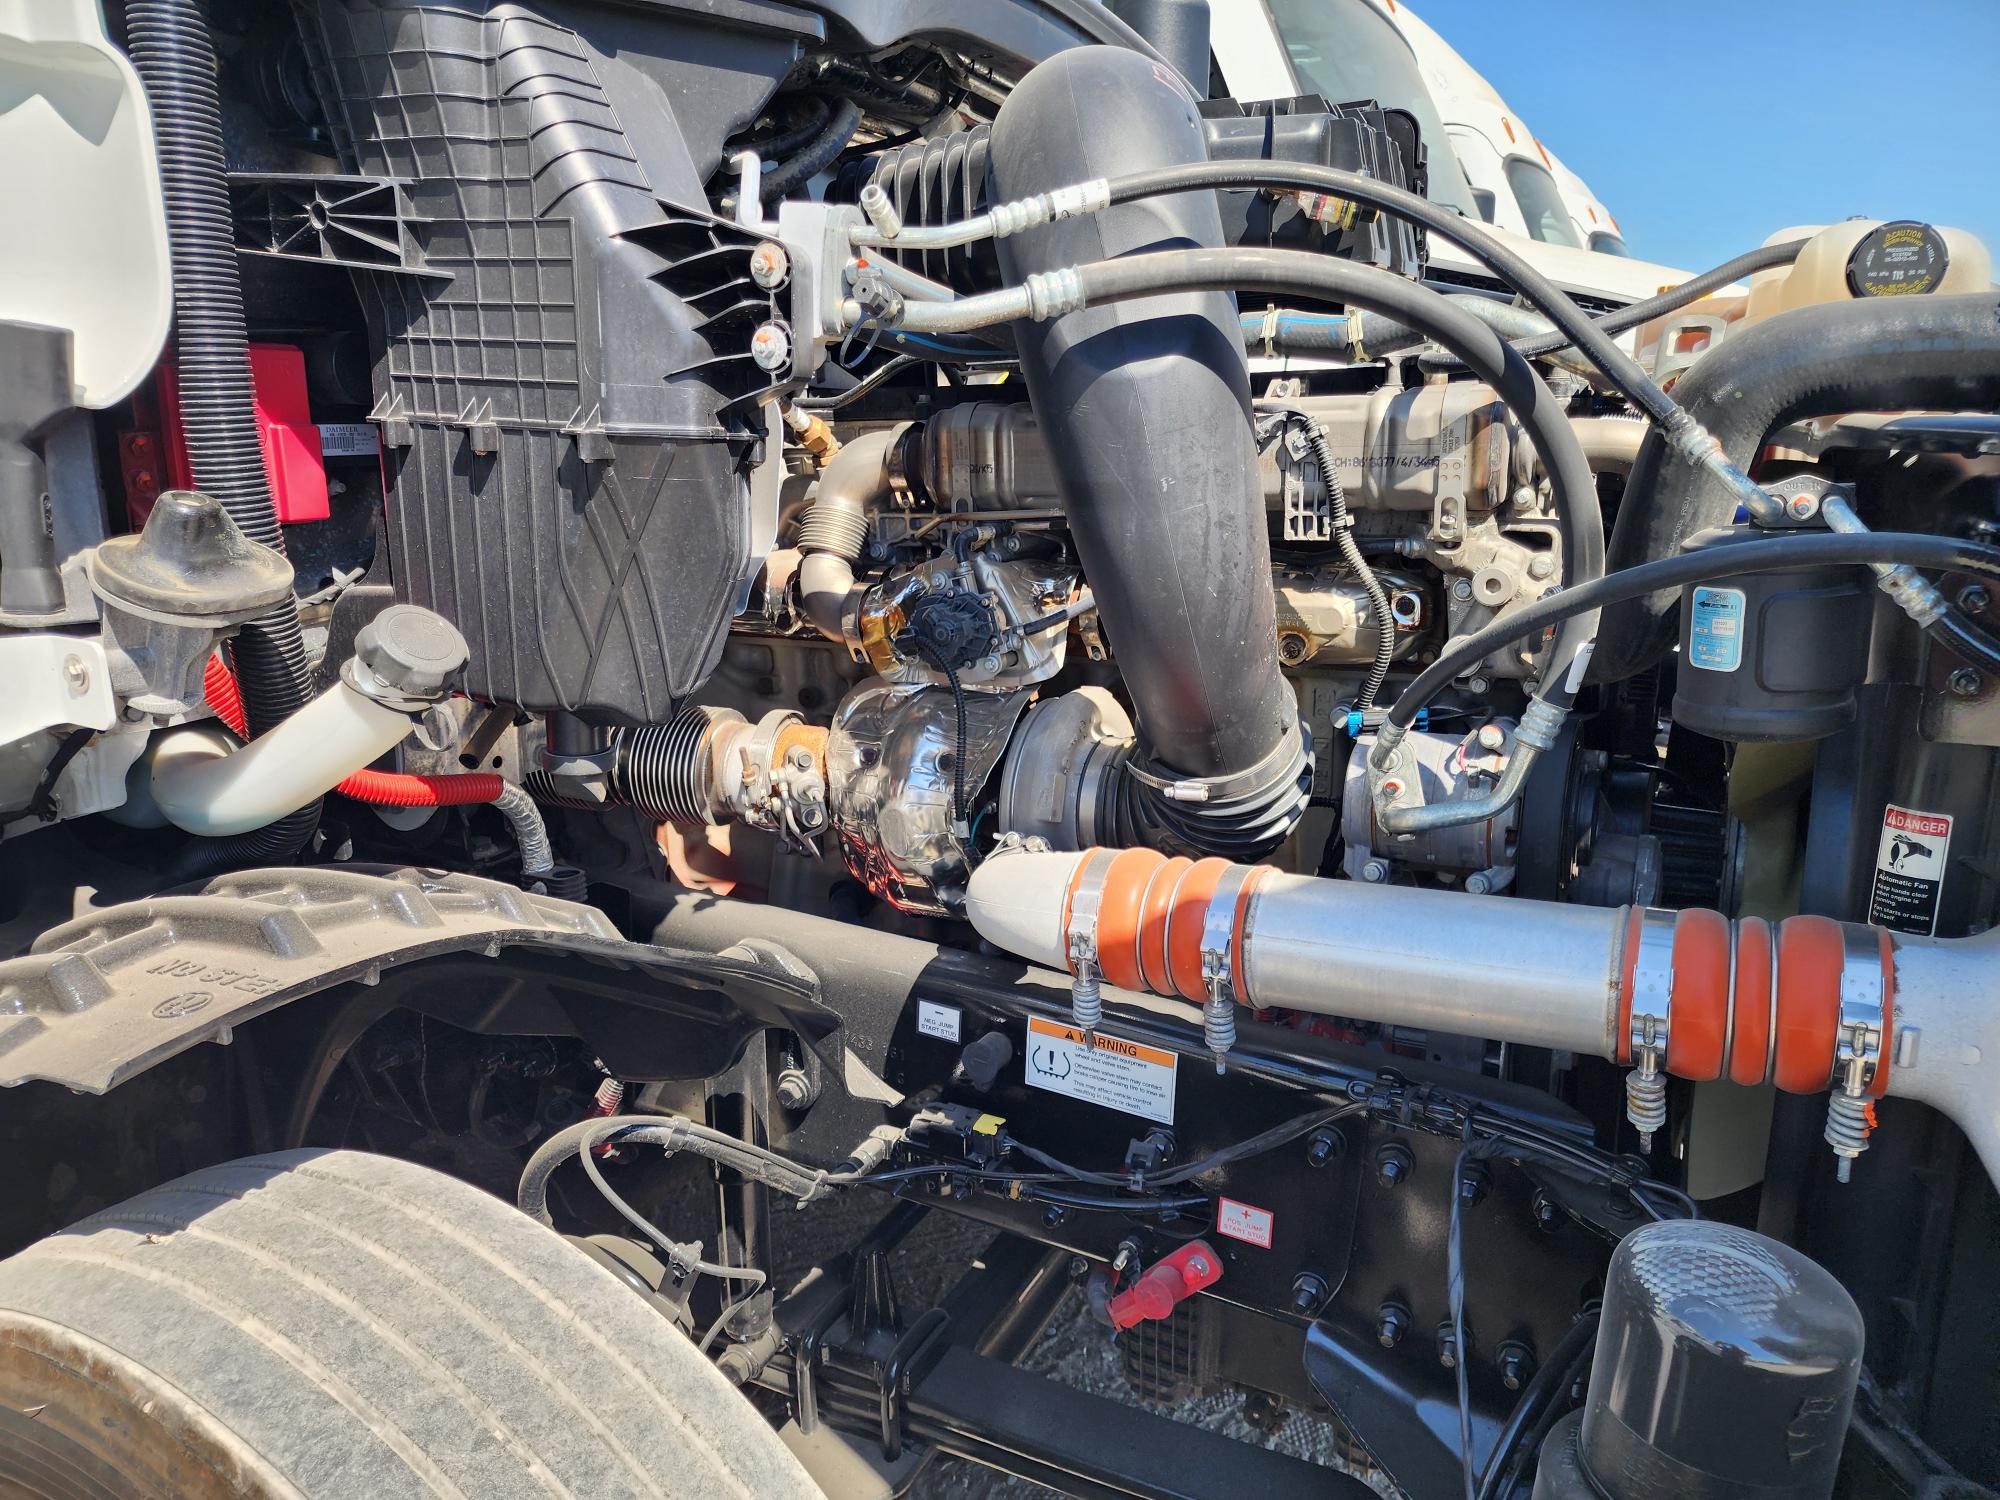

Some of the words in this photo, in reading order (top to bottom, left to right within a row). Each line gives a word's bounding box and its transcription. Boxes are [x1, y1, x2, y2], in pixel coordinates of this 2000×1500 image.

[1896, 815, 1947, 834] DANGER
[1879, 872, 1912, 887] Automatic
[1914, 882, 1928, 890] Fan
[1873, 903, 1883, 911] Fan
[921, 1023, 939, 1033] START
[940, 1029, 957, 1038] STUD
[1073, 1079, 1084, 1087] This
[1107, 1079, 1129, 1089] causing
[1129, 1078, 1141, 1086] may
[1142, 1081, 1163, 1091] contact
[1223, 1223, 1245, 1234] START
[1247, 1231, 1266, 1241] STUD
